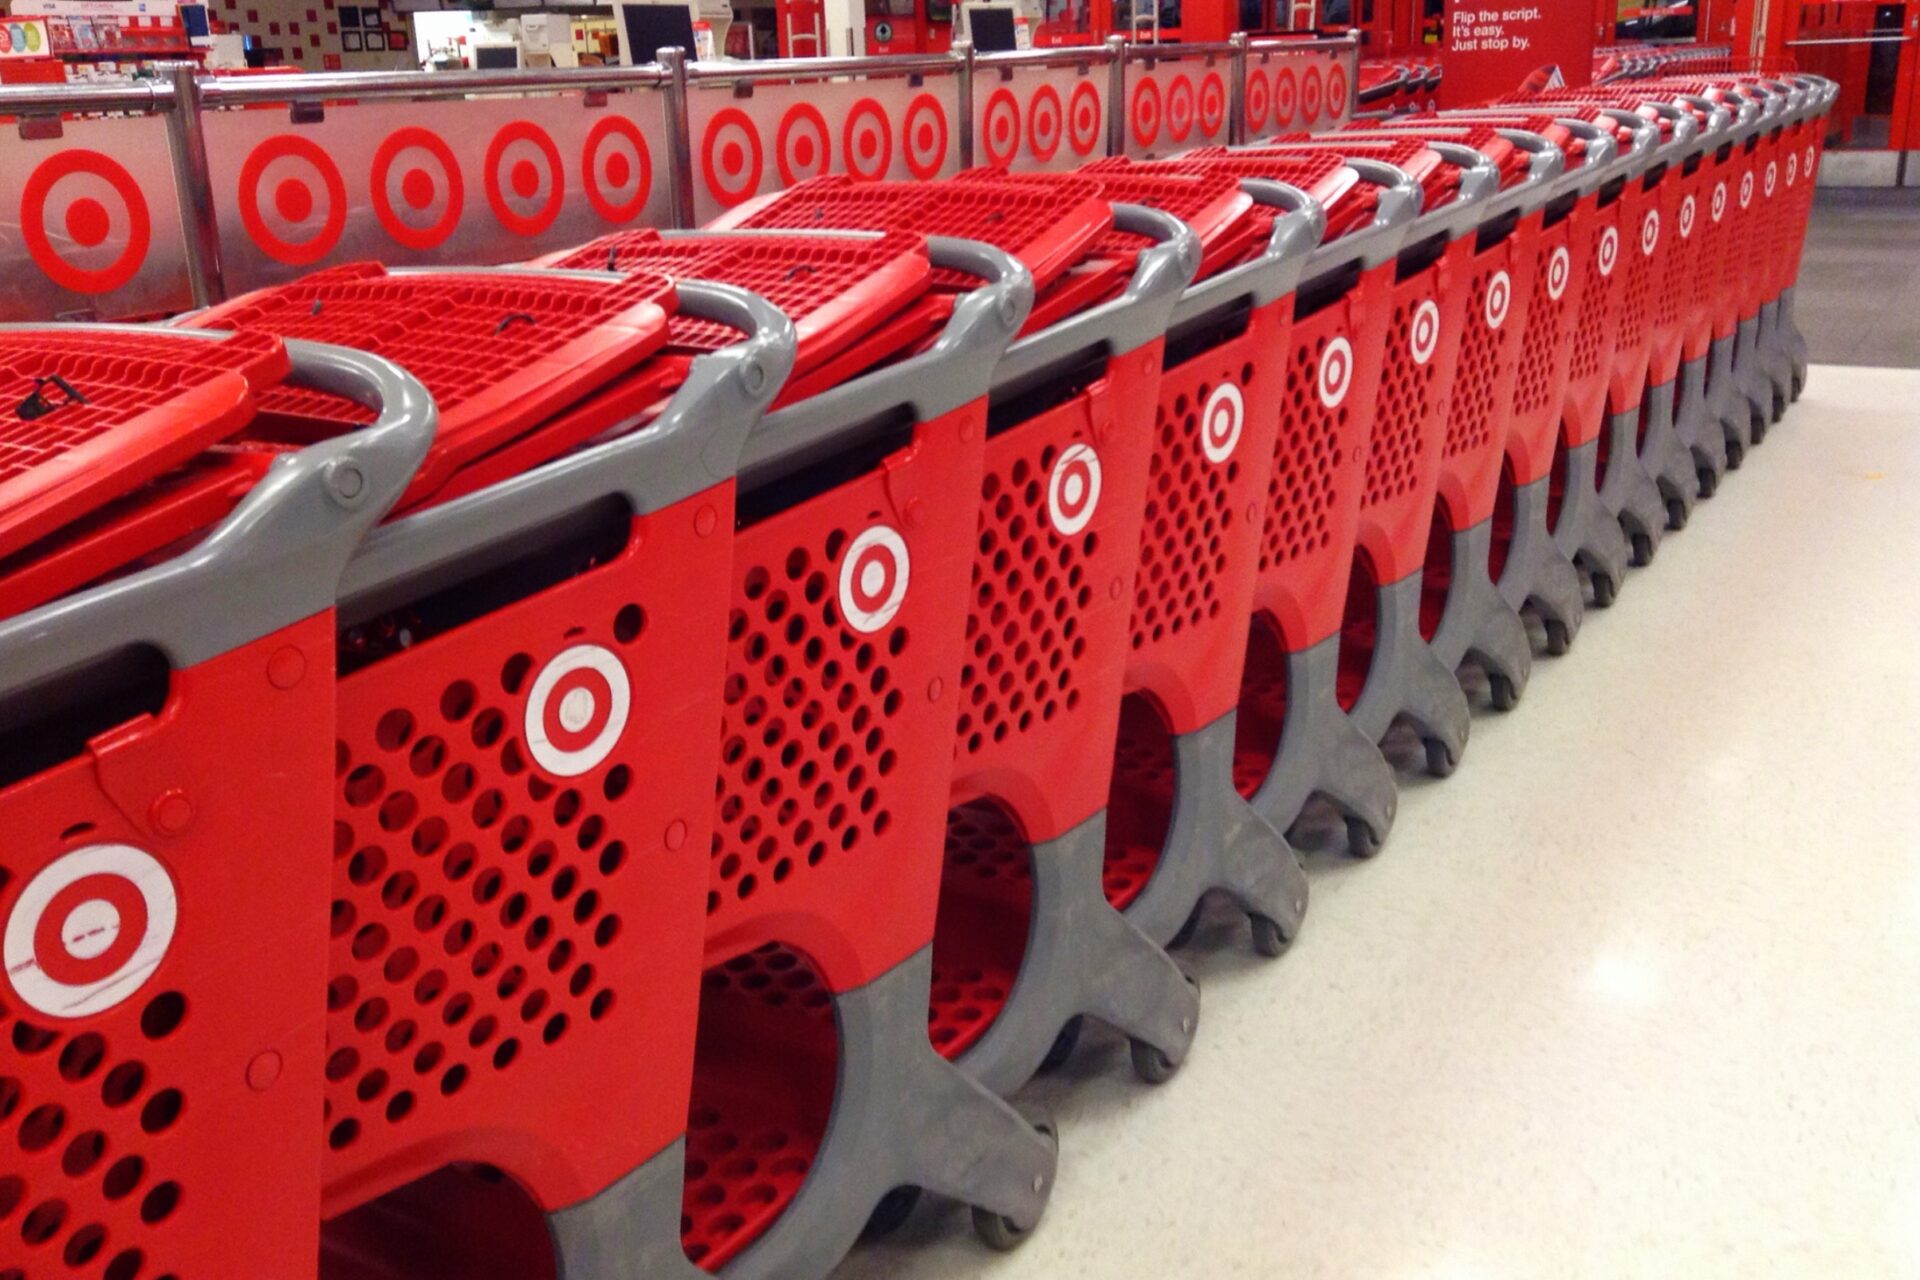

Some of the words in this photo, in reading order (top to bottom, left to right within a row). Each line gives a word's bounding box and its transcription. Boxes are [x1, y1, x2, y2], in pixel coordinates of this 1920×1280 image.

[1453, 11, 1476, 25] Flip
[1479, 10, 1499, 22] the
[1502, 8, 1541, 22] script.
[1452, 25, 1470, 37] It's
[1473, 25, 1504, 38] easy.
[1451, 39, 1478, 52] Just
[1481, 38, 1509, 51] stop
[1512, 36, 1530, 51] by.
